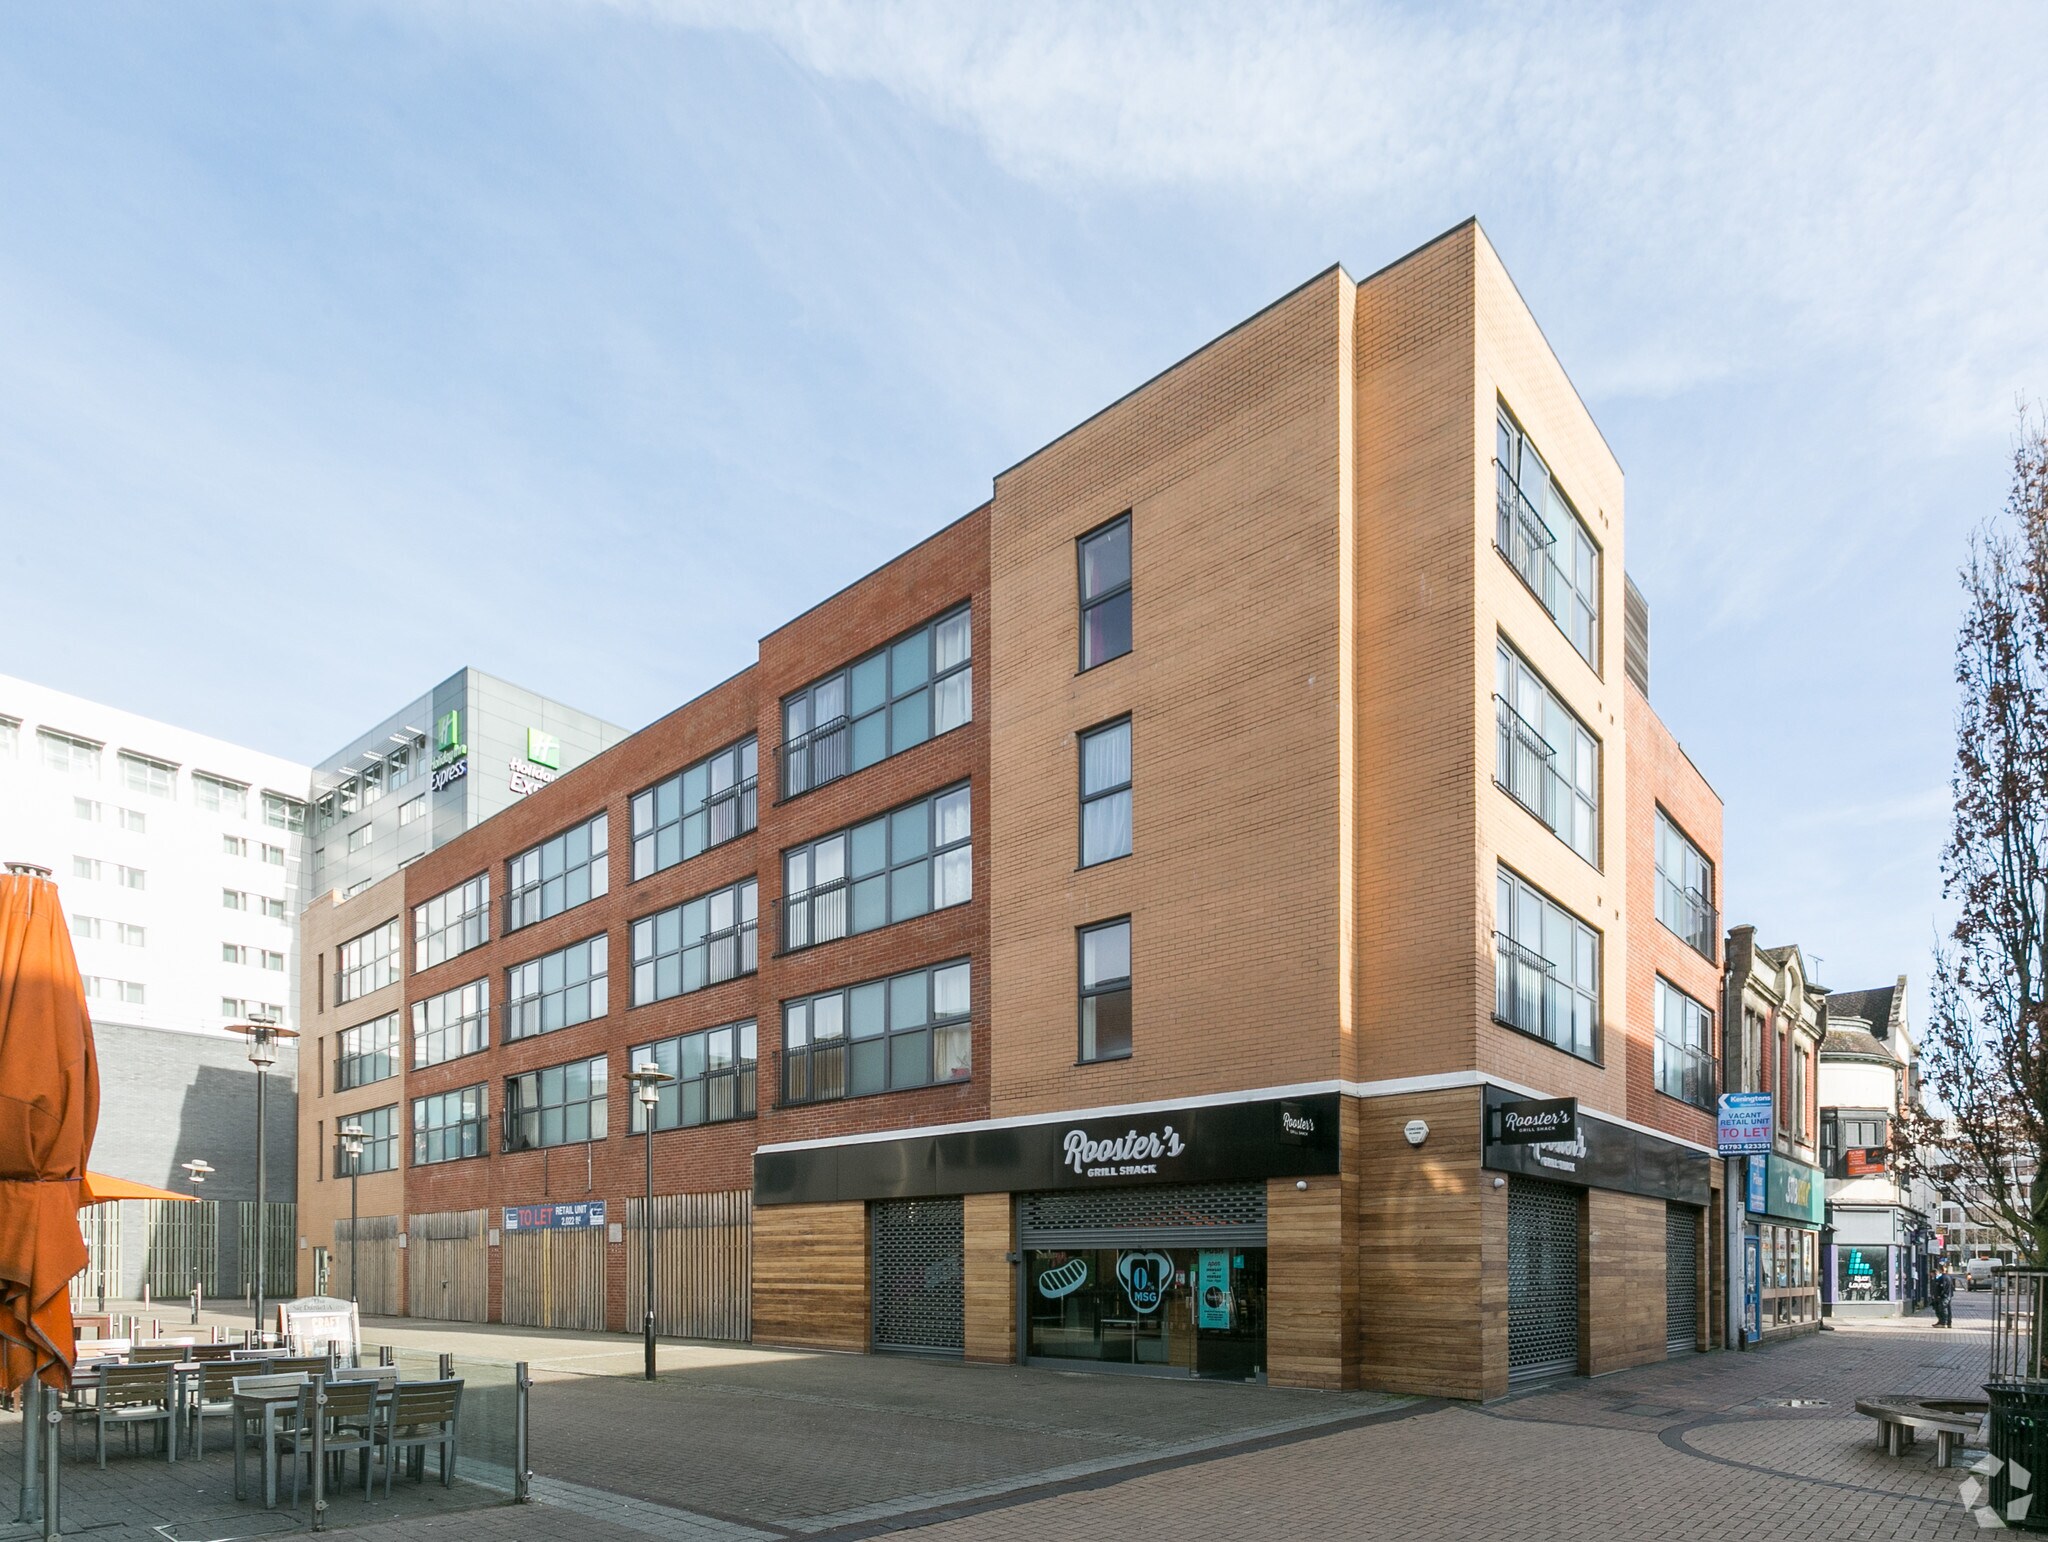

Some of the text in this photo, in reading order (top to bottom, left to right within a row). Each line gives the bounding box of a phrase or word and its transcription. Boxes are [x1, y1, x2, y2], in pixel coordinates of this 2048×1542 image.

[431, 759, 467, 791] Express
[1730, 1095, 1771, 1104] Keningtons
[1505, 1110, 1571, 1131] Rooster's
[1720, 1126, 1770, 1138] TO LET
[1063, 1125, 1186, 1174] Rooster's
[1087, 1164, 1158, 1178] GRILL SHACK
[518, 1209, 532, 1226] TO
[534, 1207, 554, 1226] LET
[555, 1204, 588, 1216] RETAIL UNIT
[561, 1216, 575, 1226] 2,022
[1134, 1291, 1157, 1302] MSG
